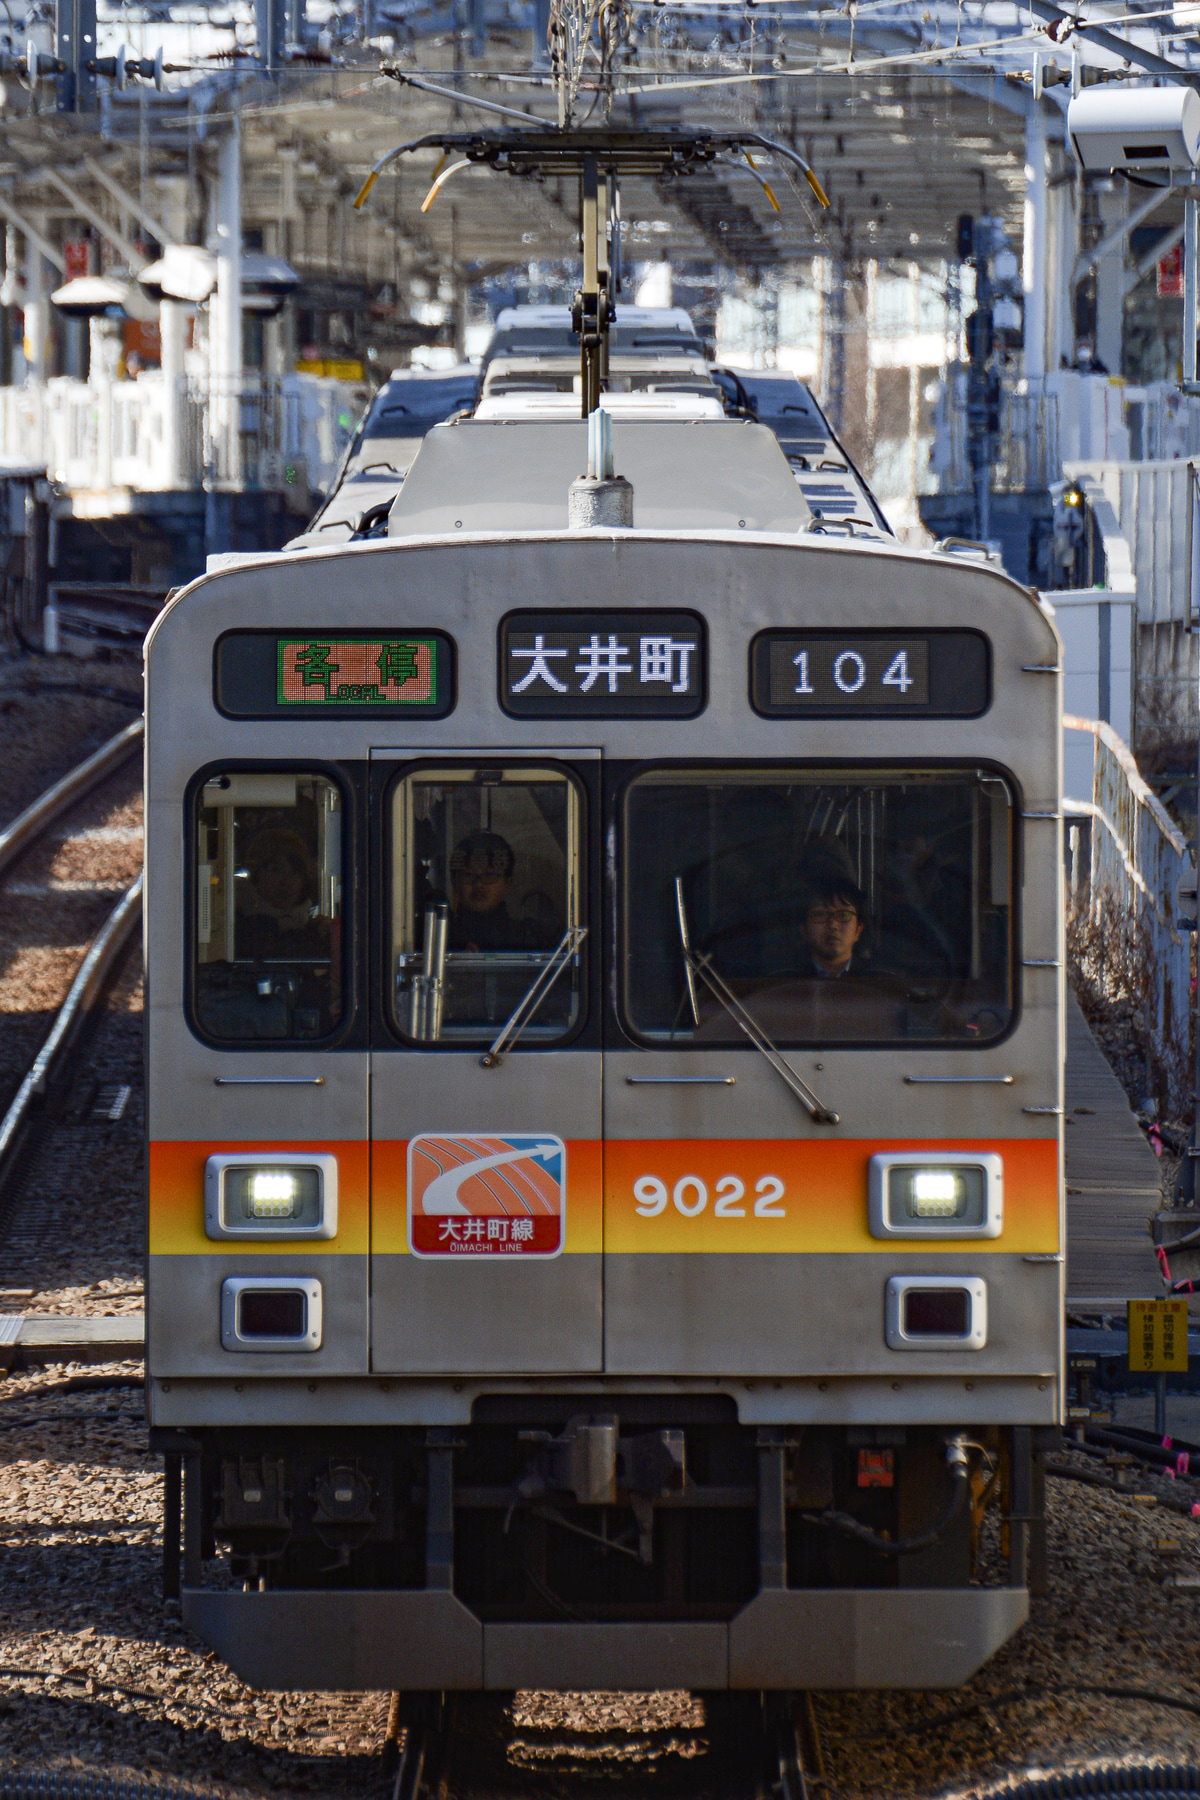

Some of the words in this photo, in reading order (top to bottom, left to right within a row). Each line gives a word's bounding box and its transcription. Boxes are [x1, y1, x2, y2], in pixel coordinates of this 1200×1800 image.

[294, 644, 418, 686] 各停
[510, 634, 697, 694] 大井町
[791, 650, 914, 693] 104
[633, 1175, 786, 1218] 9022
[438, 1218, 534, 1241] 大井町線
[499, 1243, 523, 1252] LINE
